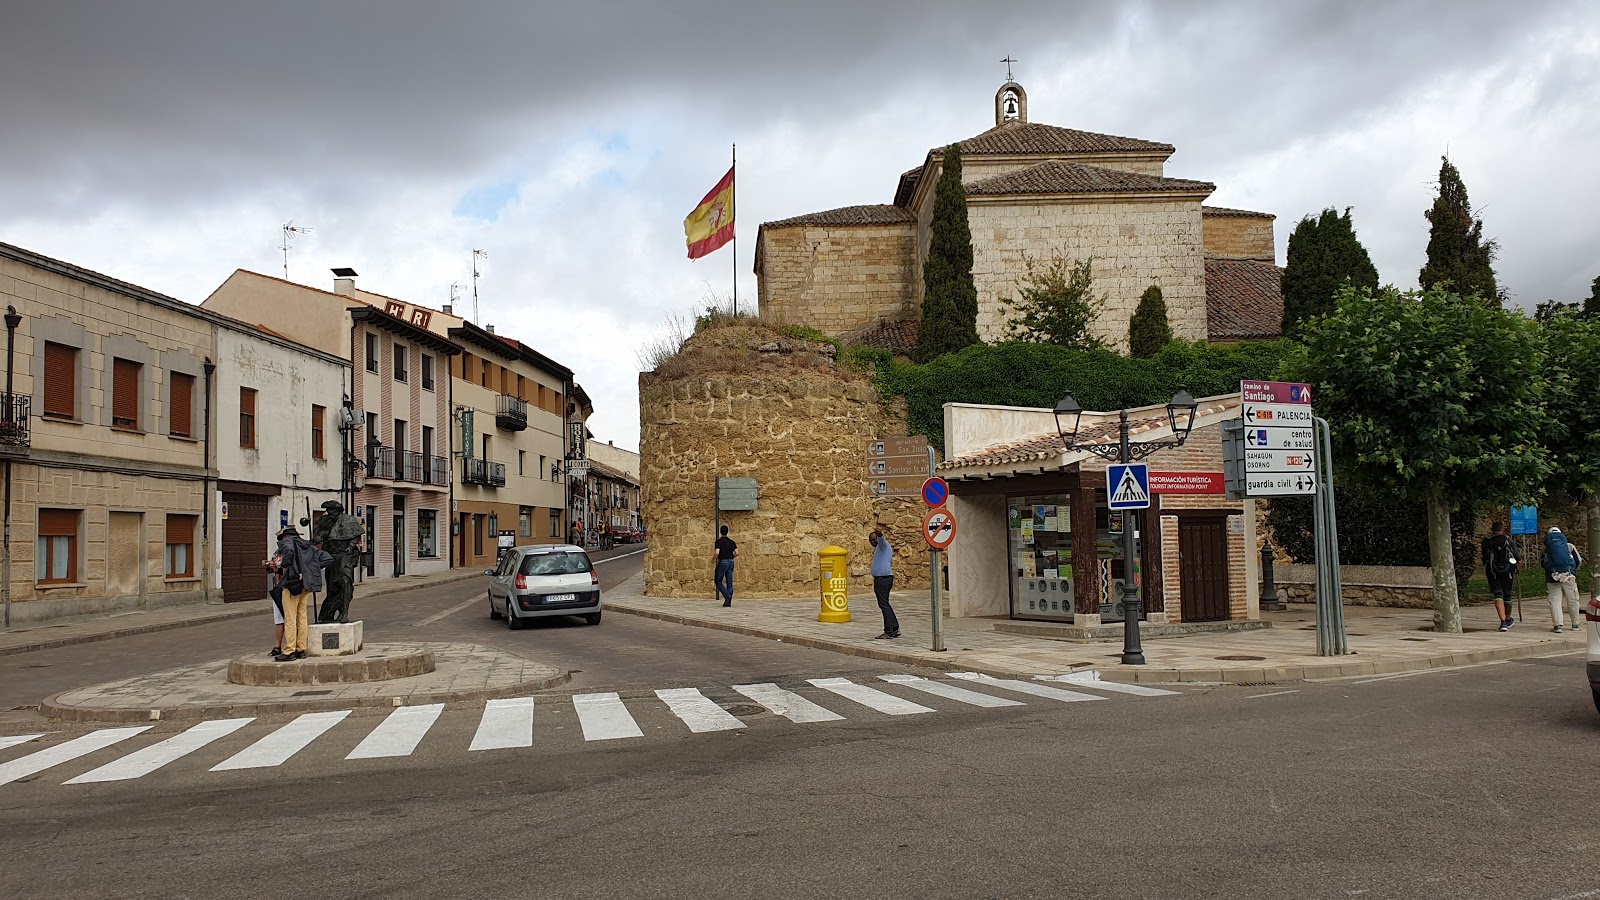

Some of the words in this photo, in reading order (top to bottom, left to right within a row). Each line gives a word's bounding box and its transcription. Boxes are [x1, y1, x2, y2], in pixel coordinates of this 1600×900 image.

[1244, 391, 1275, 402] Santiago
[1277, 411, 1311, 420] PALENCIA
[1248, 480, 1274, 490] guardia
[1277, 480, 1292, 488] civil
